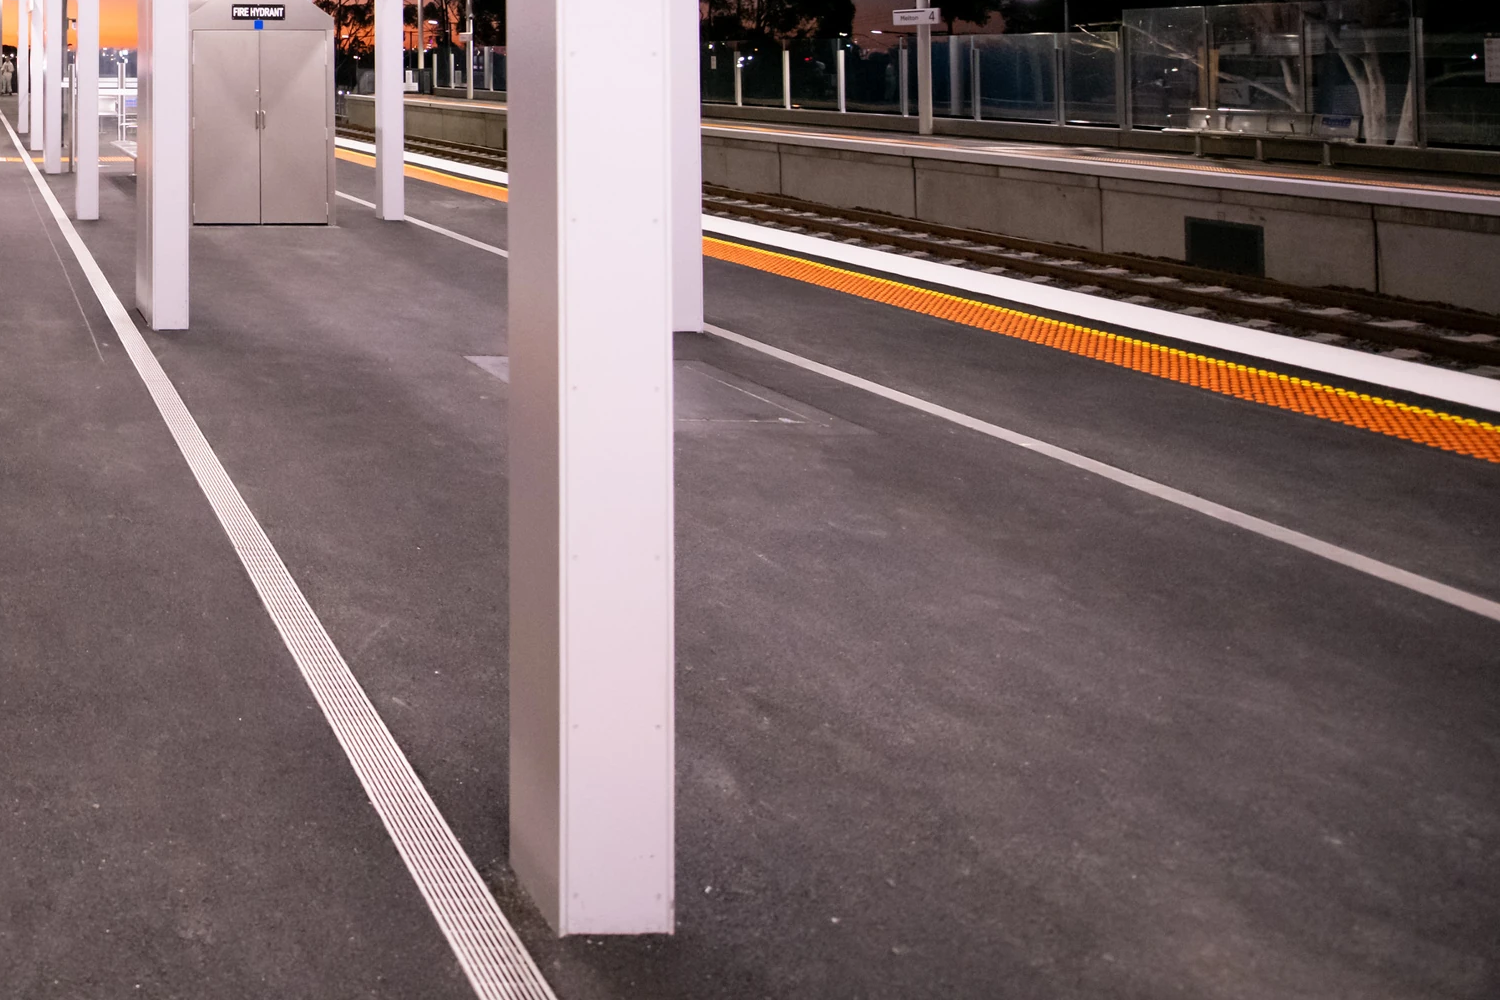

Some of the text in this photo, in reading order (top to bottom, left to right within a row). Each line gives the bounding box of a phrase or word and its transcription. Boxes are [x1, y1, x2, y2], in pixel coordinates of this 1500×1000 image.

[233, 7, 284, 17] FIRE HYDRANT
[928, 10, 935, 21] 4
